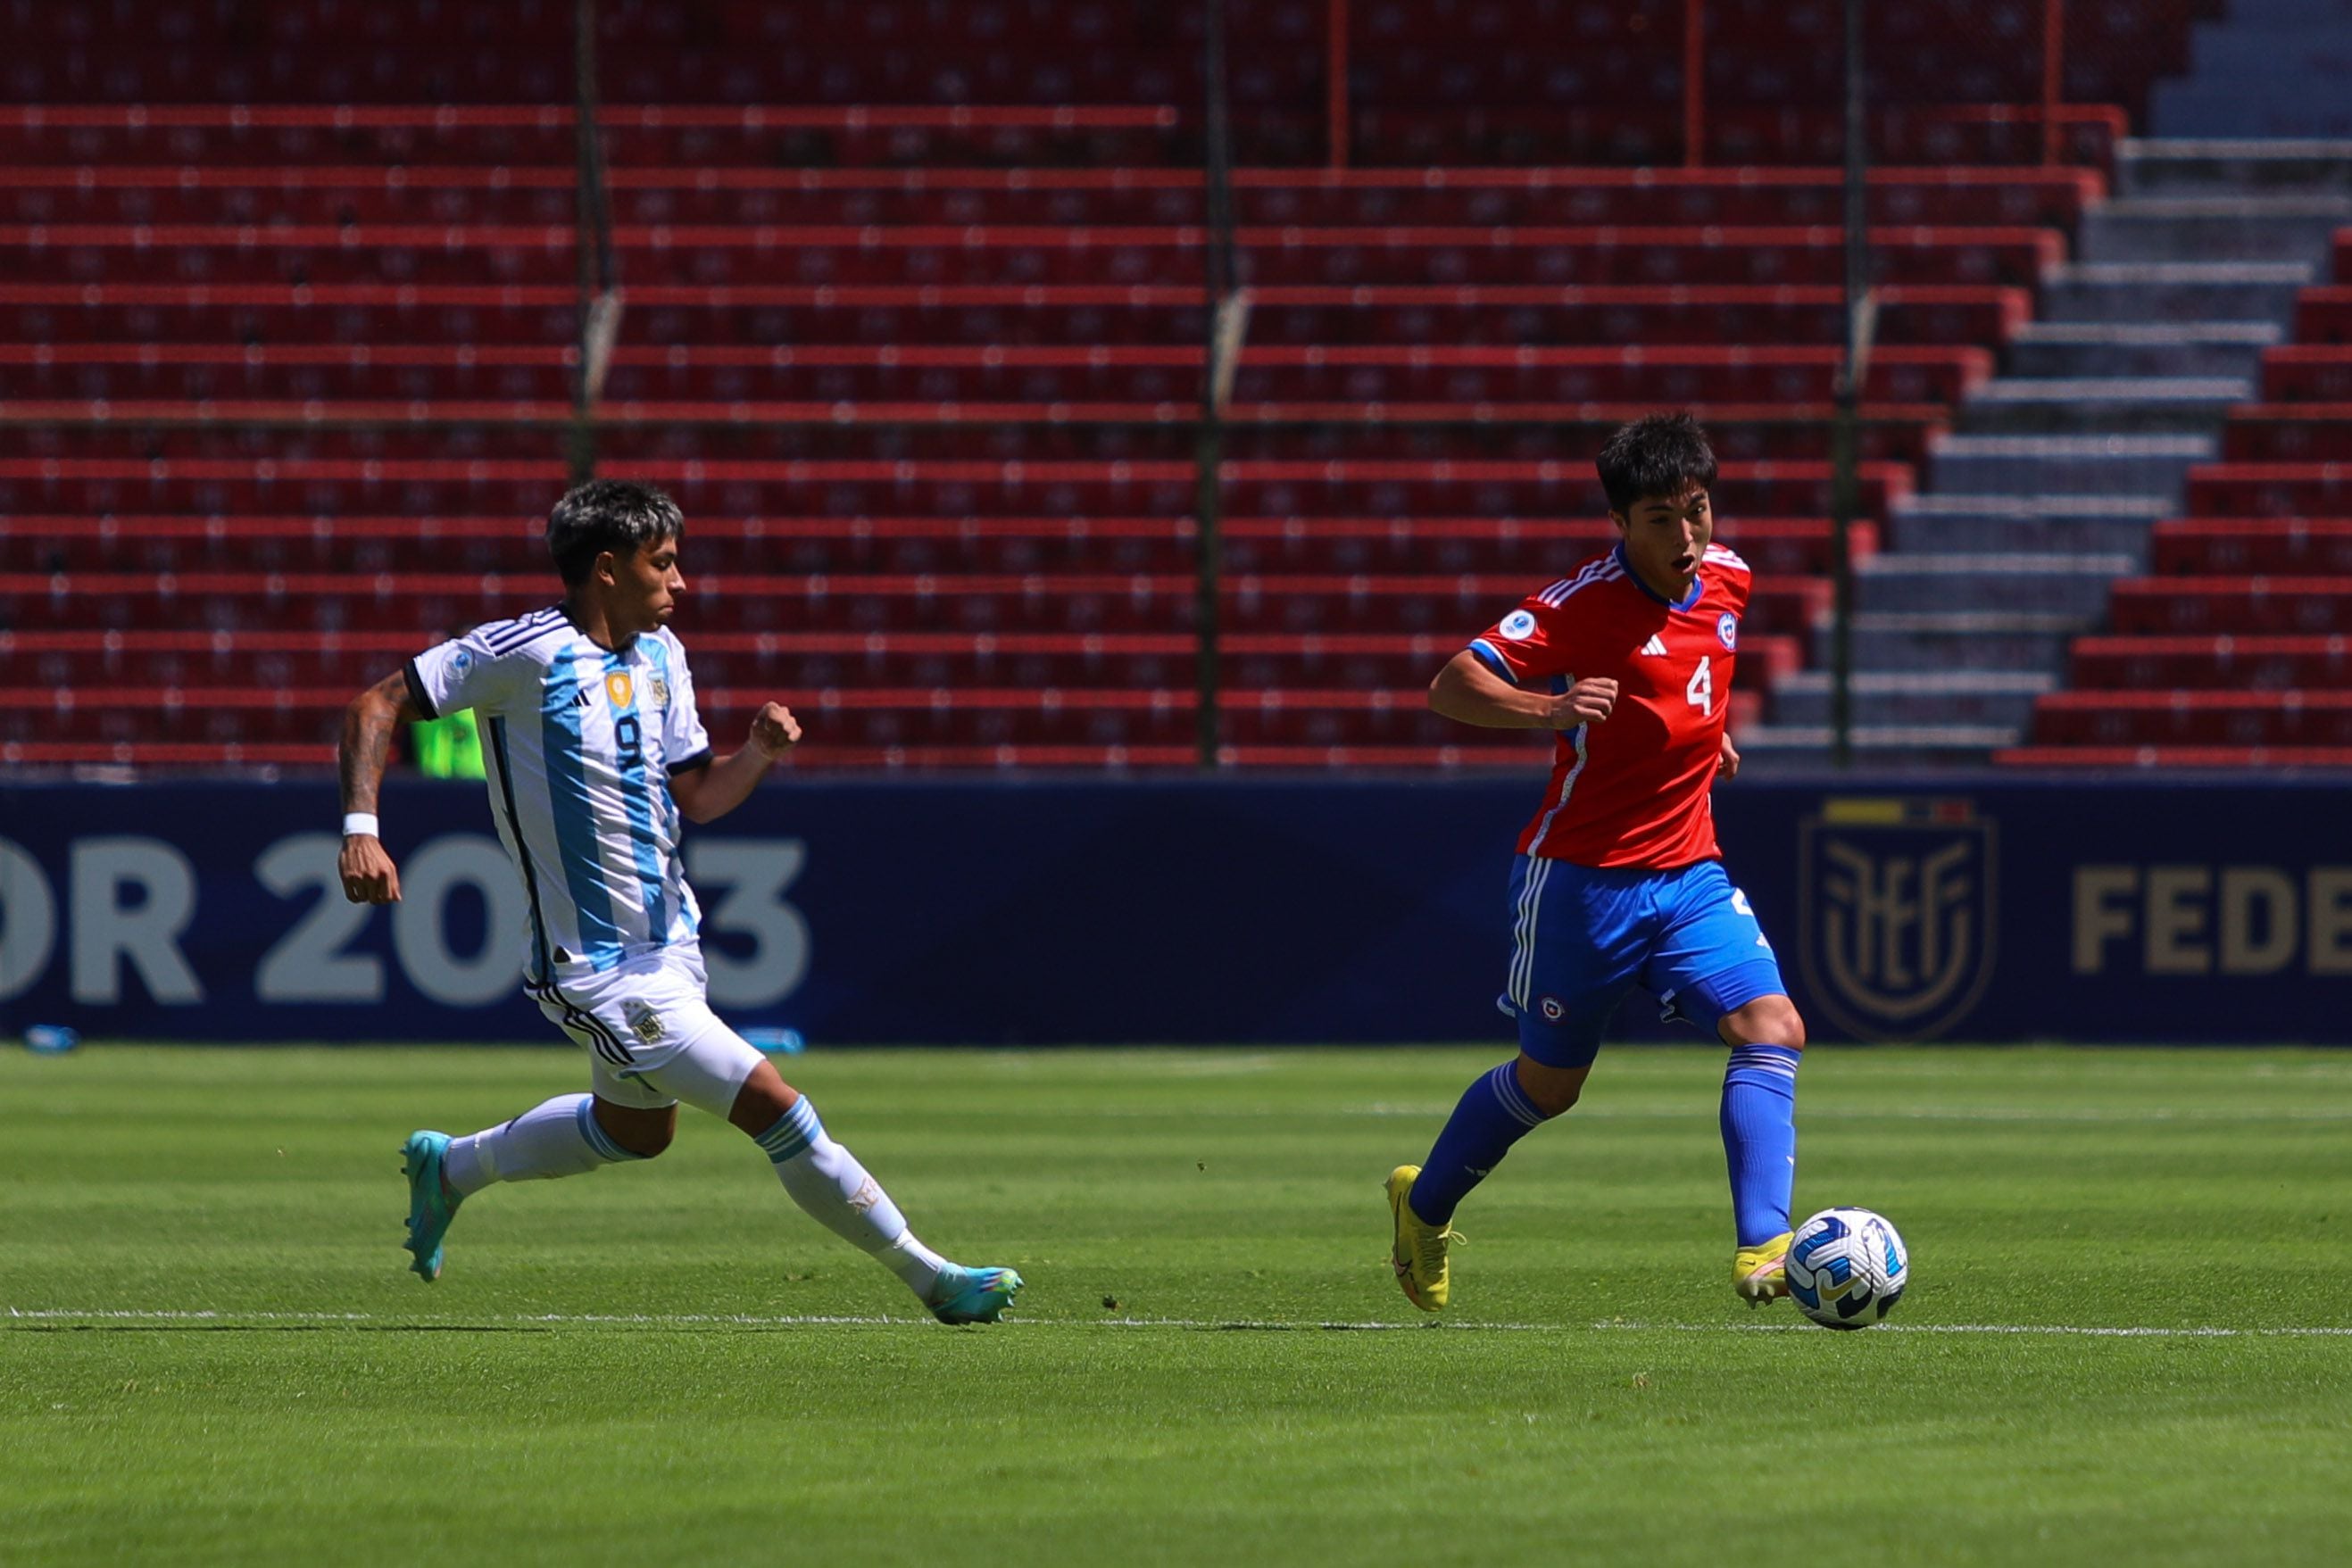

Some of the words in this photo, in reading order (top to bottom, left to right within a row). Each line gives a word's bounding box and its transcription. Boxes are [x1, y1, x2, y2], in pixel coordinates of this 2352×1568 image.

[1685, 655, 1713, 718] 4
[614, 715, 642, 775] 9
[254, 834, 810, 1006] 203
